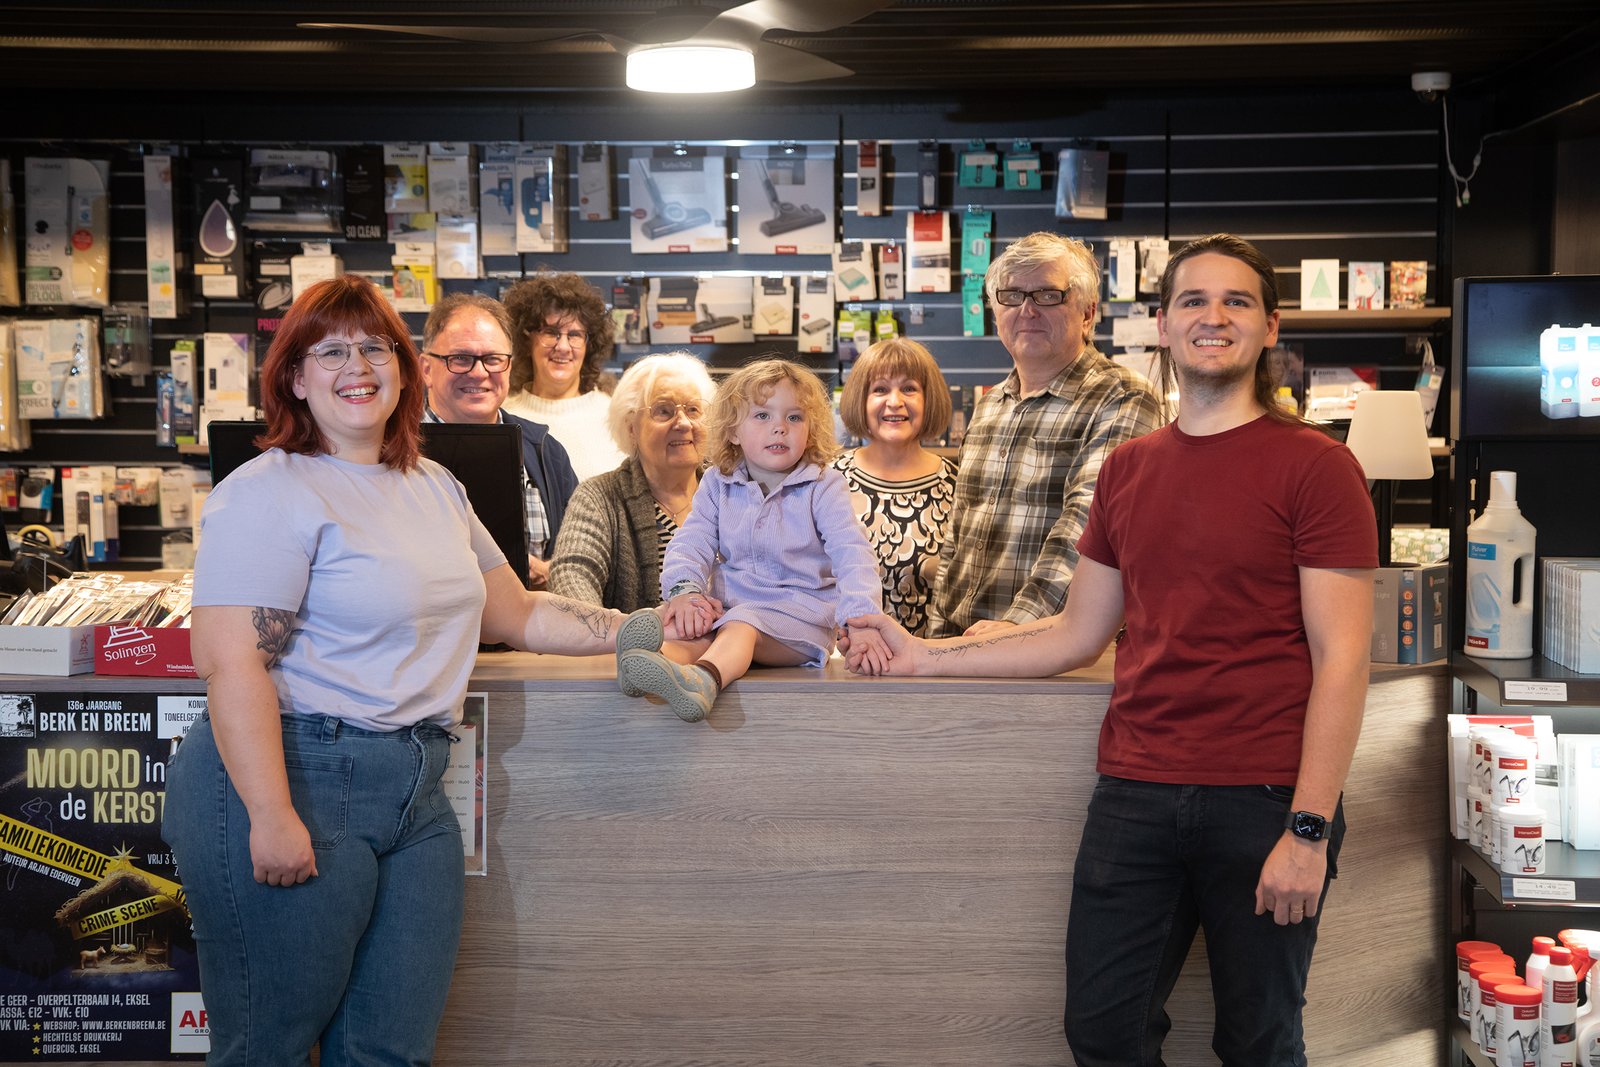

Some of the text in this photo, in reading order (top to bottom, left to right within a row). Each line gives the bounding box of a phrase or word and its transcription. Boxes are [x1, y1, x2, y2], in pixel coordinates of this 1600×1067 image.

[346, 224, 381, 239] SO CLEAN
[1468, 638, 1486, 646] Miele
[104, 643, 157, 662] Solingen
[67, 700, 122, 711] 136e JAARGANG
[188, 699, 208, 709] KONIN
[40, 712, 151, 732] BERK EN BREEM
[164, 712, 200, 722] TONEELGEZ
[27, 748, 165, 789] MOORD in
[60, 791, 87, 821] de
[0, 818, 111, 878] AMILIEKOMEDIE
[147, 853, 163, 865] VRIJ
[164, 853, 170, 865] 3
[3, 852, 82, 888] AUTEUR ARJAN EDERVEEN
[78, 911, 119, 935] CRIME
[119, 897, 160, 922] SCENE
[0, 994, 5, 1006] E
[7, 994, 28, 1006] GEER
[37, 994, 110, 1006] OVERPELTERBAAN
[111, 994, 124, 1007] 14,
[126, 993, 151, 1006] EKSEL
[0, 1006, 26, 1019] ASSA:
[28, 1006, 43, 1019] €12
[52, 1006, 72, 1019] VVK:
[75, 1006, 90, 1018] €10
[0, 1019, 166, 1031] VK VIA: WEBSHOP: WWW.BERKENBREEM.BE
[43, 1032, 122, 1043] HECHTELSE DRUKKERIJ
[42, 1043, 101, 1055] QUERCUS, EKSEL
